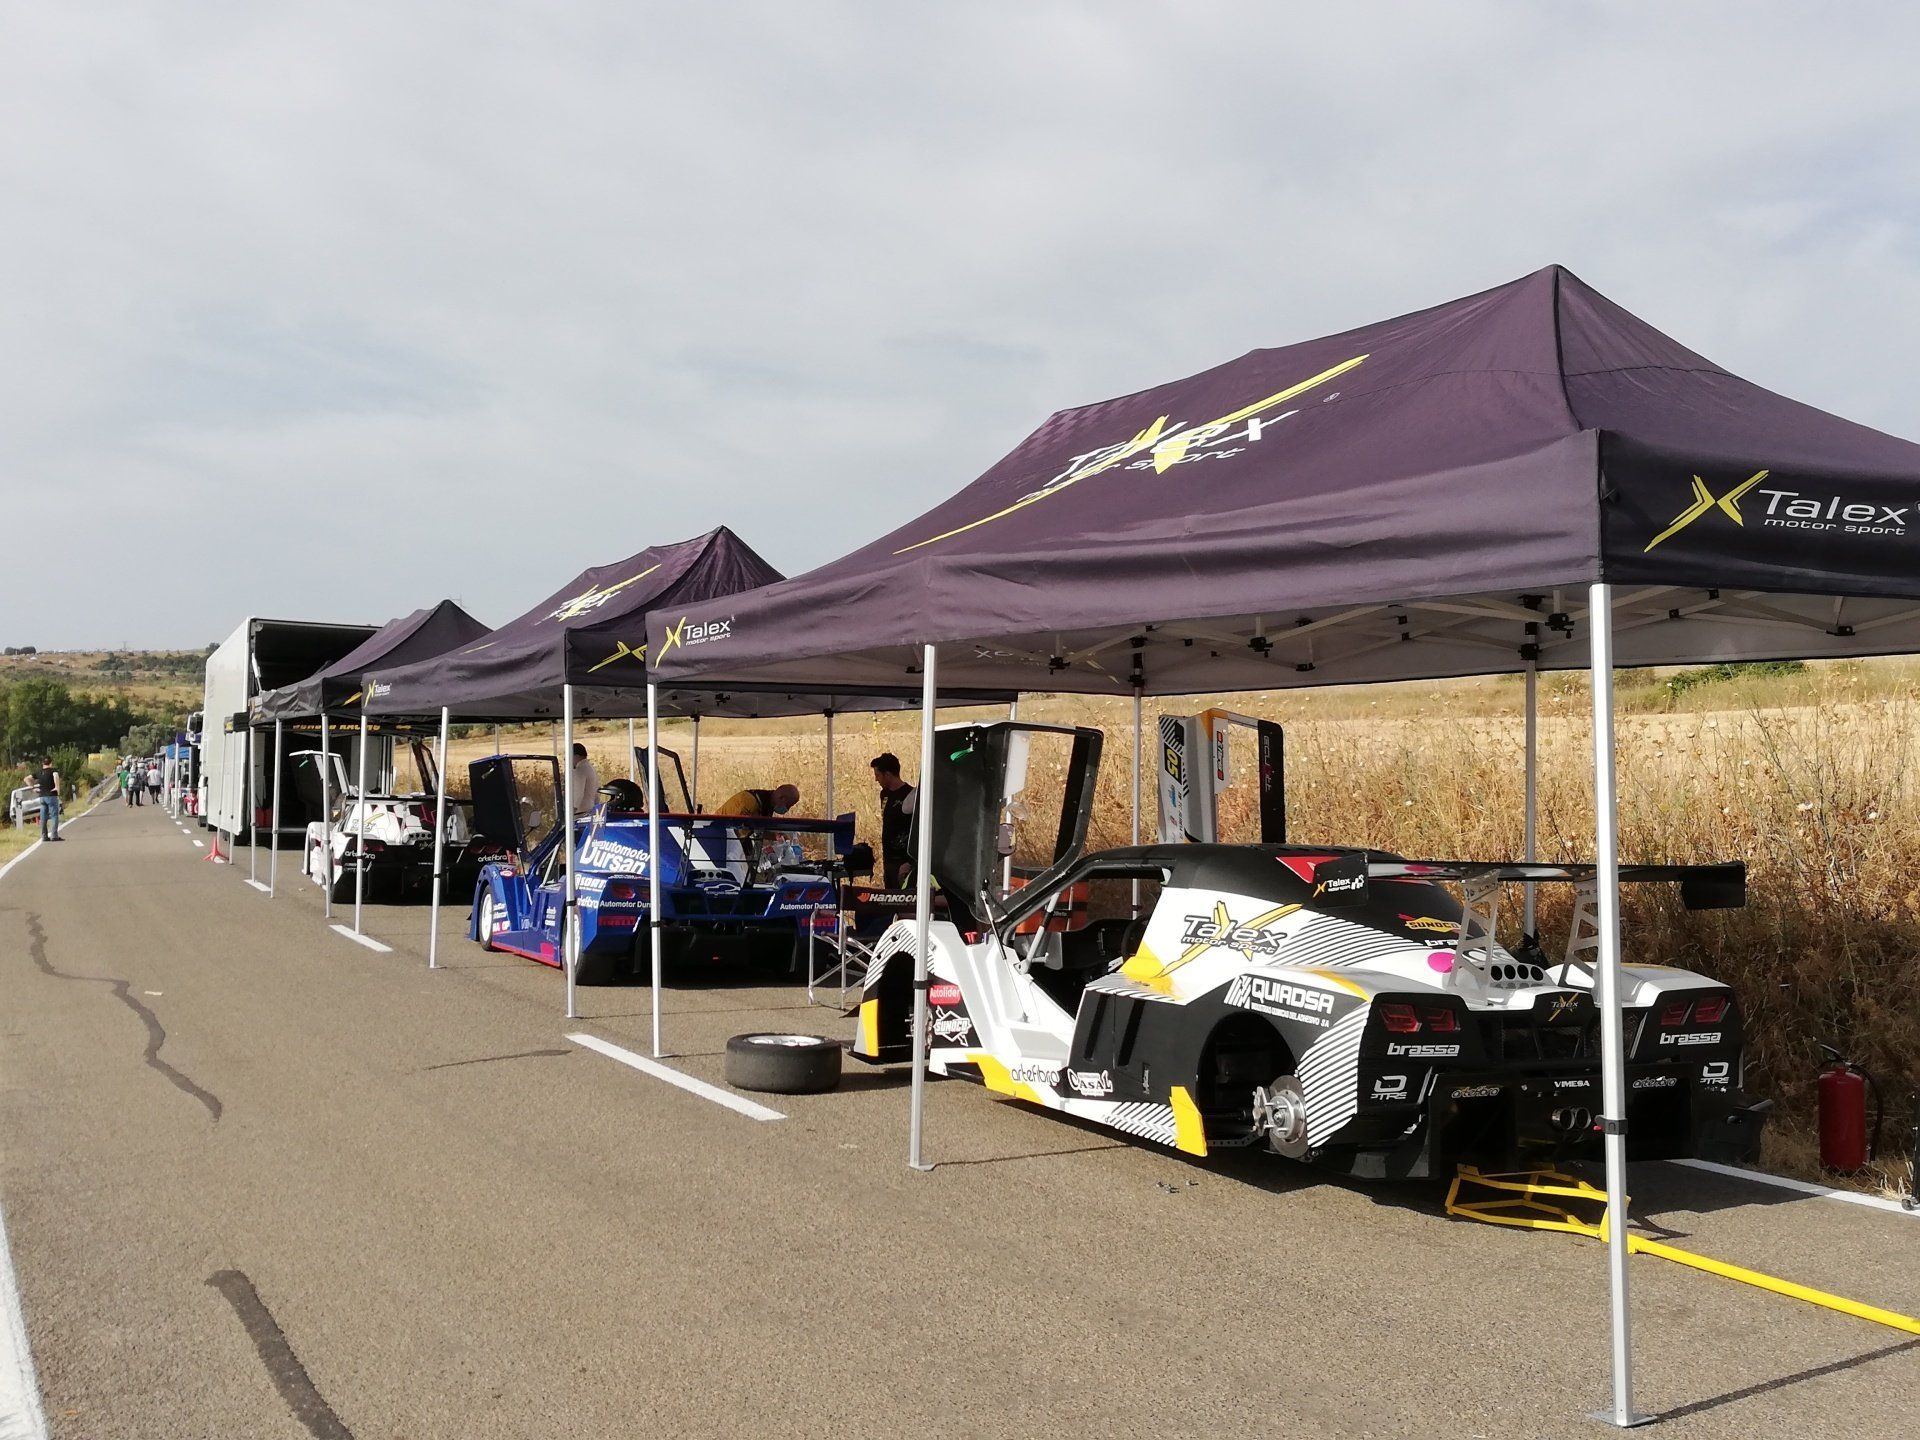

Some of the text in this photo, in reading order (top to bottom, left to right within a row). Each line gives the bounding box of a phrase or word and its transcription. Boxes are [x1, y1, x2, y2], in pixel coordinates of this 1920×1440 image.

[1758, 489, 1908, 525] Talex
[1764, 518, 1905, 536] motor sport
[683, 620, 731, 640] Talex
[685, 632, 731, 646] motor sport
[1327, 878, 1351, 888] Talex
[599, 900, 636, 908] Automotor
[780, 902, 837, 911] Automotor Dursan
[1183, 914, 1288, 947] Talex
[1409, 920, 1460, 929] SUNOCO
[1181, 935, 1280, 954] motor sport
[935, 1019, 969, 1033] SUNOCO
[1659, 1032, 1722, 1045] brassa
[1387, 1042, 1461, 1057] brassa
[1554, 1080, 1590, 1088] VIMESA
